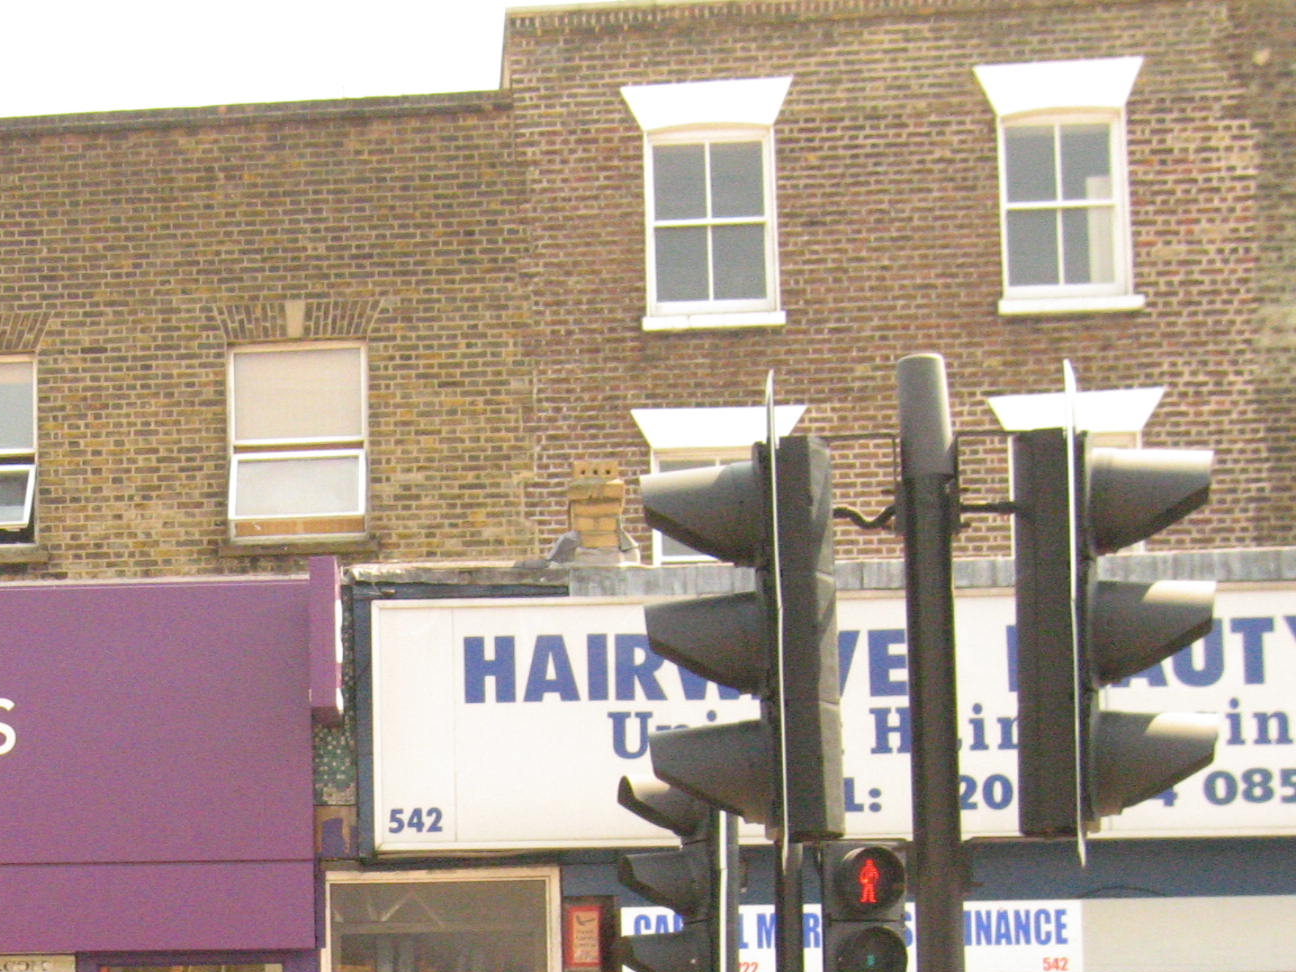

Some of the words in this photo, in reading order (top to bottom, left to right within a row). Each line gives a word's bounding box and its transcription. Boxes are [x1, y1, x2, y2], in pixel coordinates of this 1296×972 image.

[388, 807, 443, 833] 542
[964, 909, 1068, 946] INANCE
[1043, 957, 1069, 971] 542
